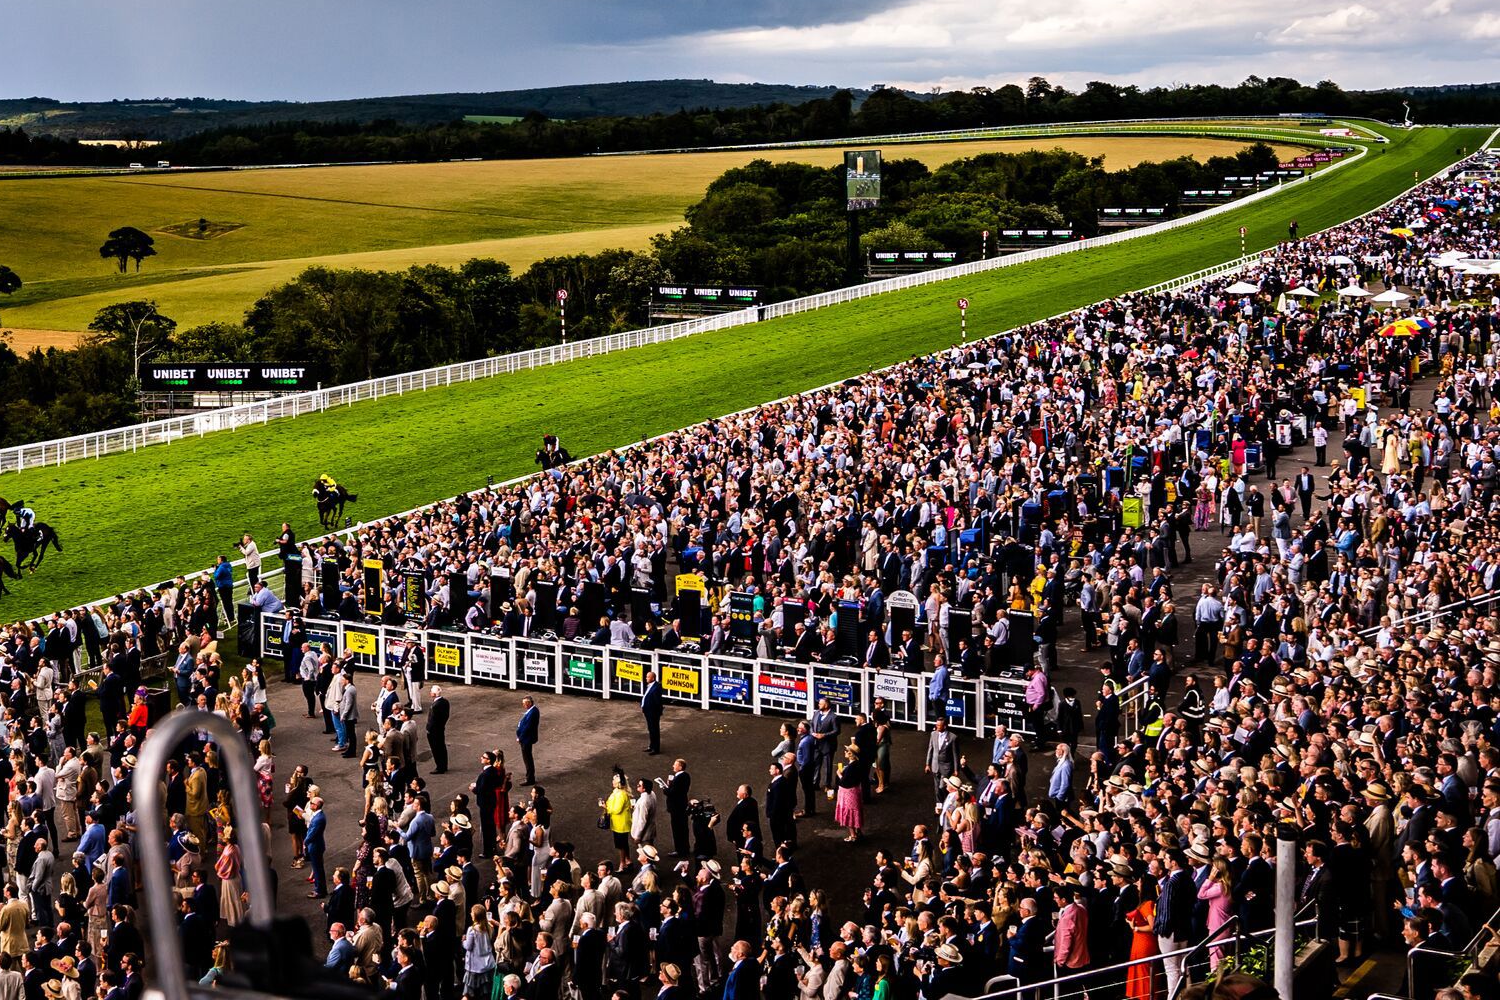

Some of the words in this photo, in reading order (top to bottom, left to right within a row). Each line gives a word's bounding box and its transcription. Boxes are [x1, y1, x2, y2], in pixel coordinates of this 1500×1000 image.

[659, 287, 688, 295] UNIBET
[693, 288, 723, 296] UNIBET
[728, 289, 758, 297] UNIBET
[153, 369, 197, 379] UNIBET
[207, 368, 251, 379] UNIBET
[261, 368, 306, 379] UNIBET
[436, 648, 458, 656] OLYMPIC
[438, 653, 457, 661] RACING
[571, 667, 592, 676] HOOPER
[619, 668, 640, 677] HOOPER
[671, 672, 690, 681] KEITH
[666, 678, 694, 689] JOHNSON
[770, 678, 796, 688] WHITE
[759, 685, 807, 699] SUNDERLAND
[876, 684, 905, 694] CHRISTIE
[997, 707, 1023, 716] HOOPER
